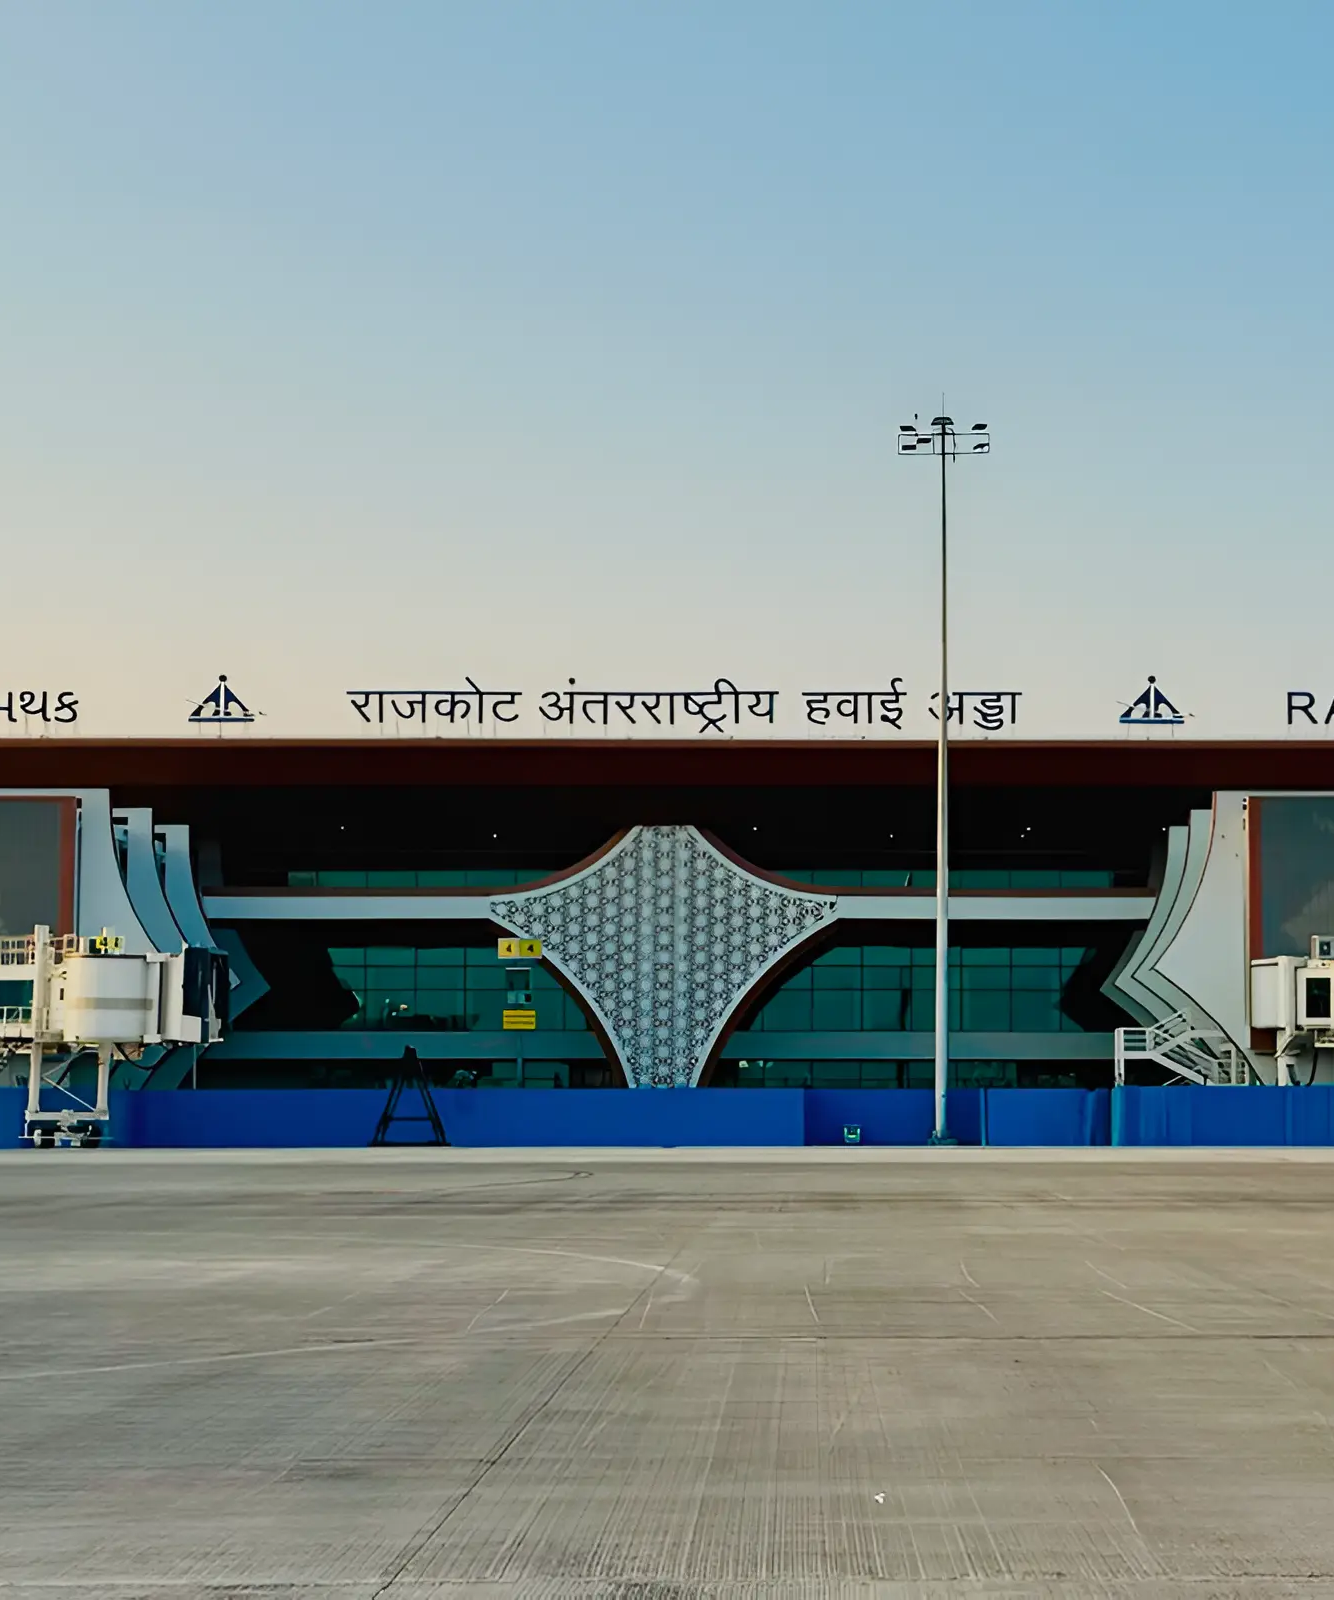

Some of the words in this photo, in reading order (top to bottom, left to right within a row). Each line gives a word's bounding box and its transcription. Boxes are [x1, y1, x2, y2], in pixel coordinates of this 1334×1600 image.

[347, 677, 523, 724] राजकोट
[539, 678, 780, 734] अंतरराष्ट्रीय
[802, 677, 908, 730] हवाई
[928, 691, 1023, 731] अड्डा
